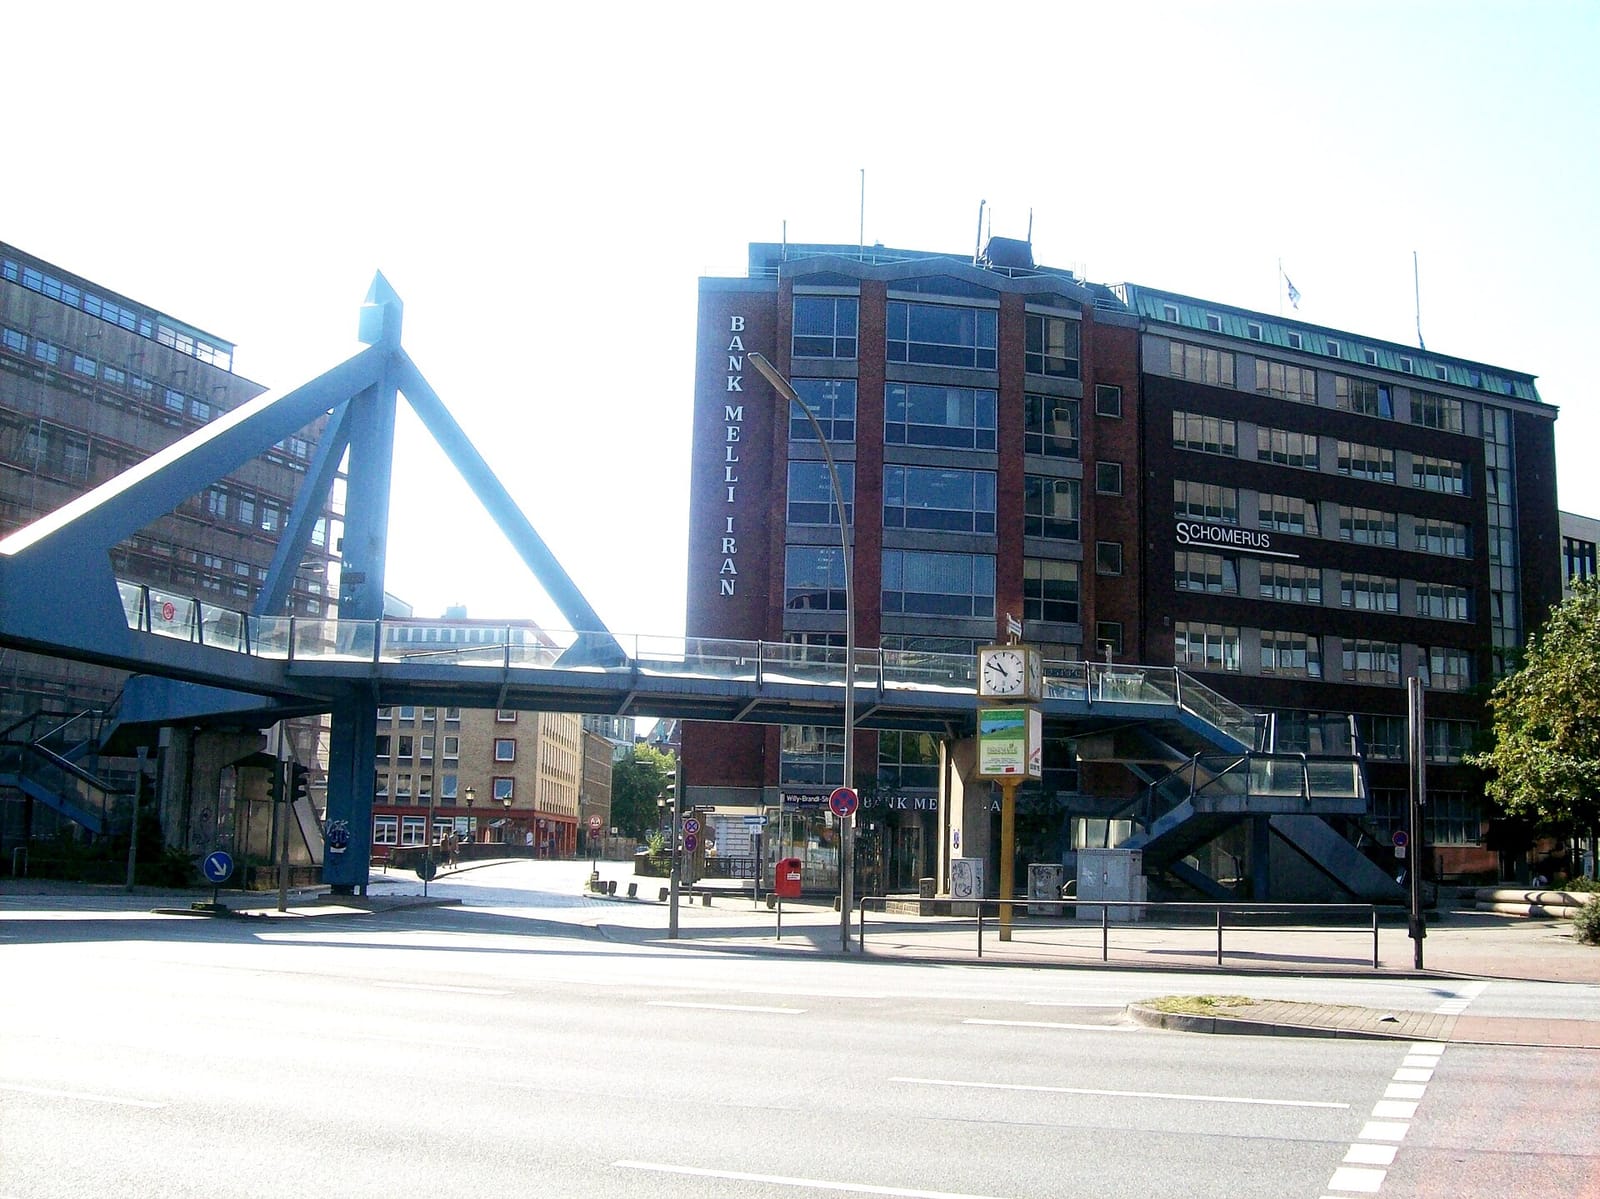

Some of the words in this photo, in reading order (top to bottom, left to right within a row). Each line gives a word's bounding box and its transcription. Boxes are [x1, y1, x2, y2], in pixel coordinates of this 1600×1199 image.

[727, 315, 745, 392] BANK
[724, 405, 743, 503] MELLI
[719, 517, 738, 596] IRAN
[1176, 522, 1270, 548] SCHOMERUS
